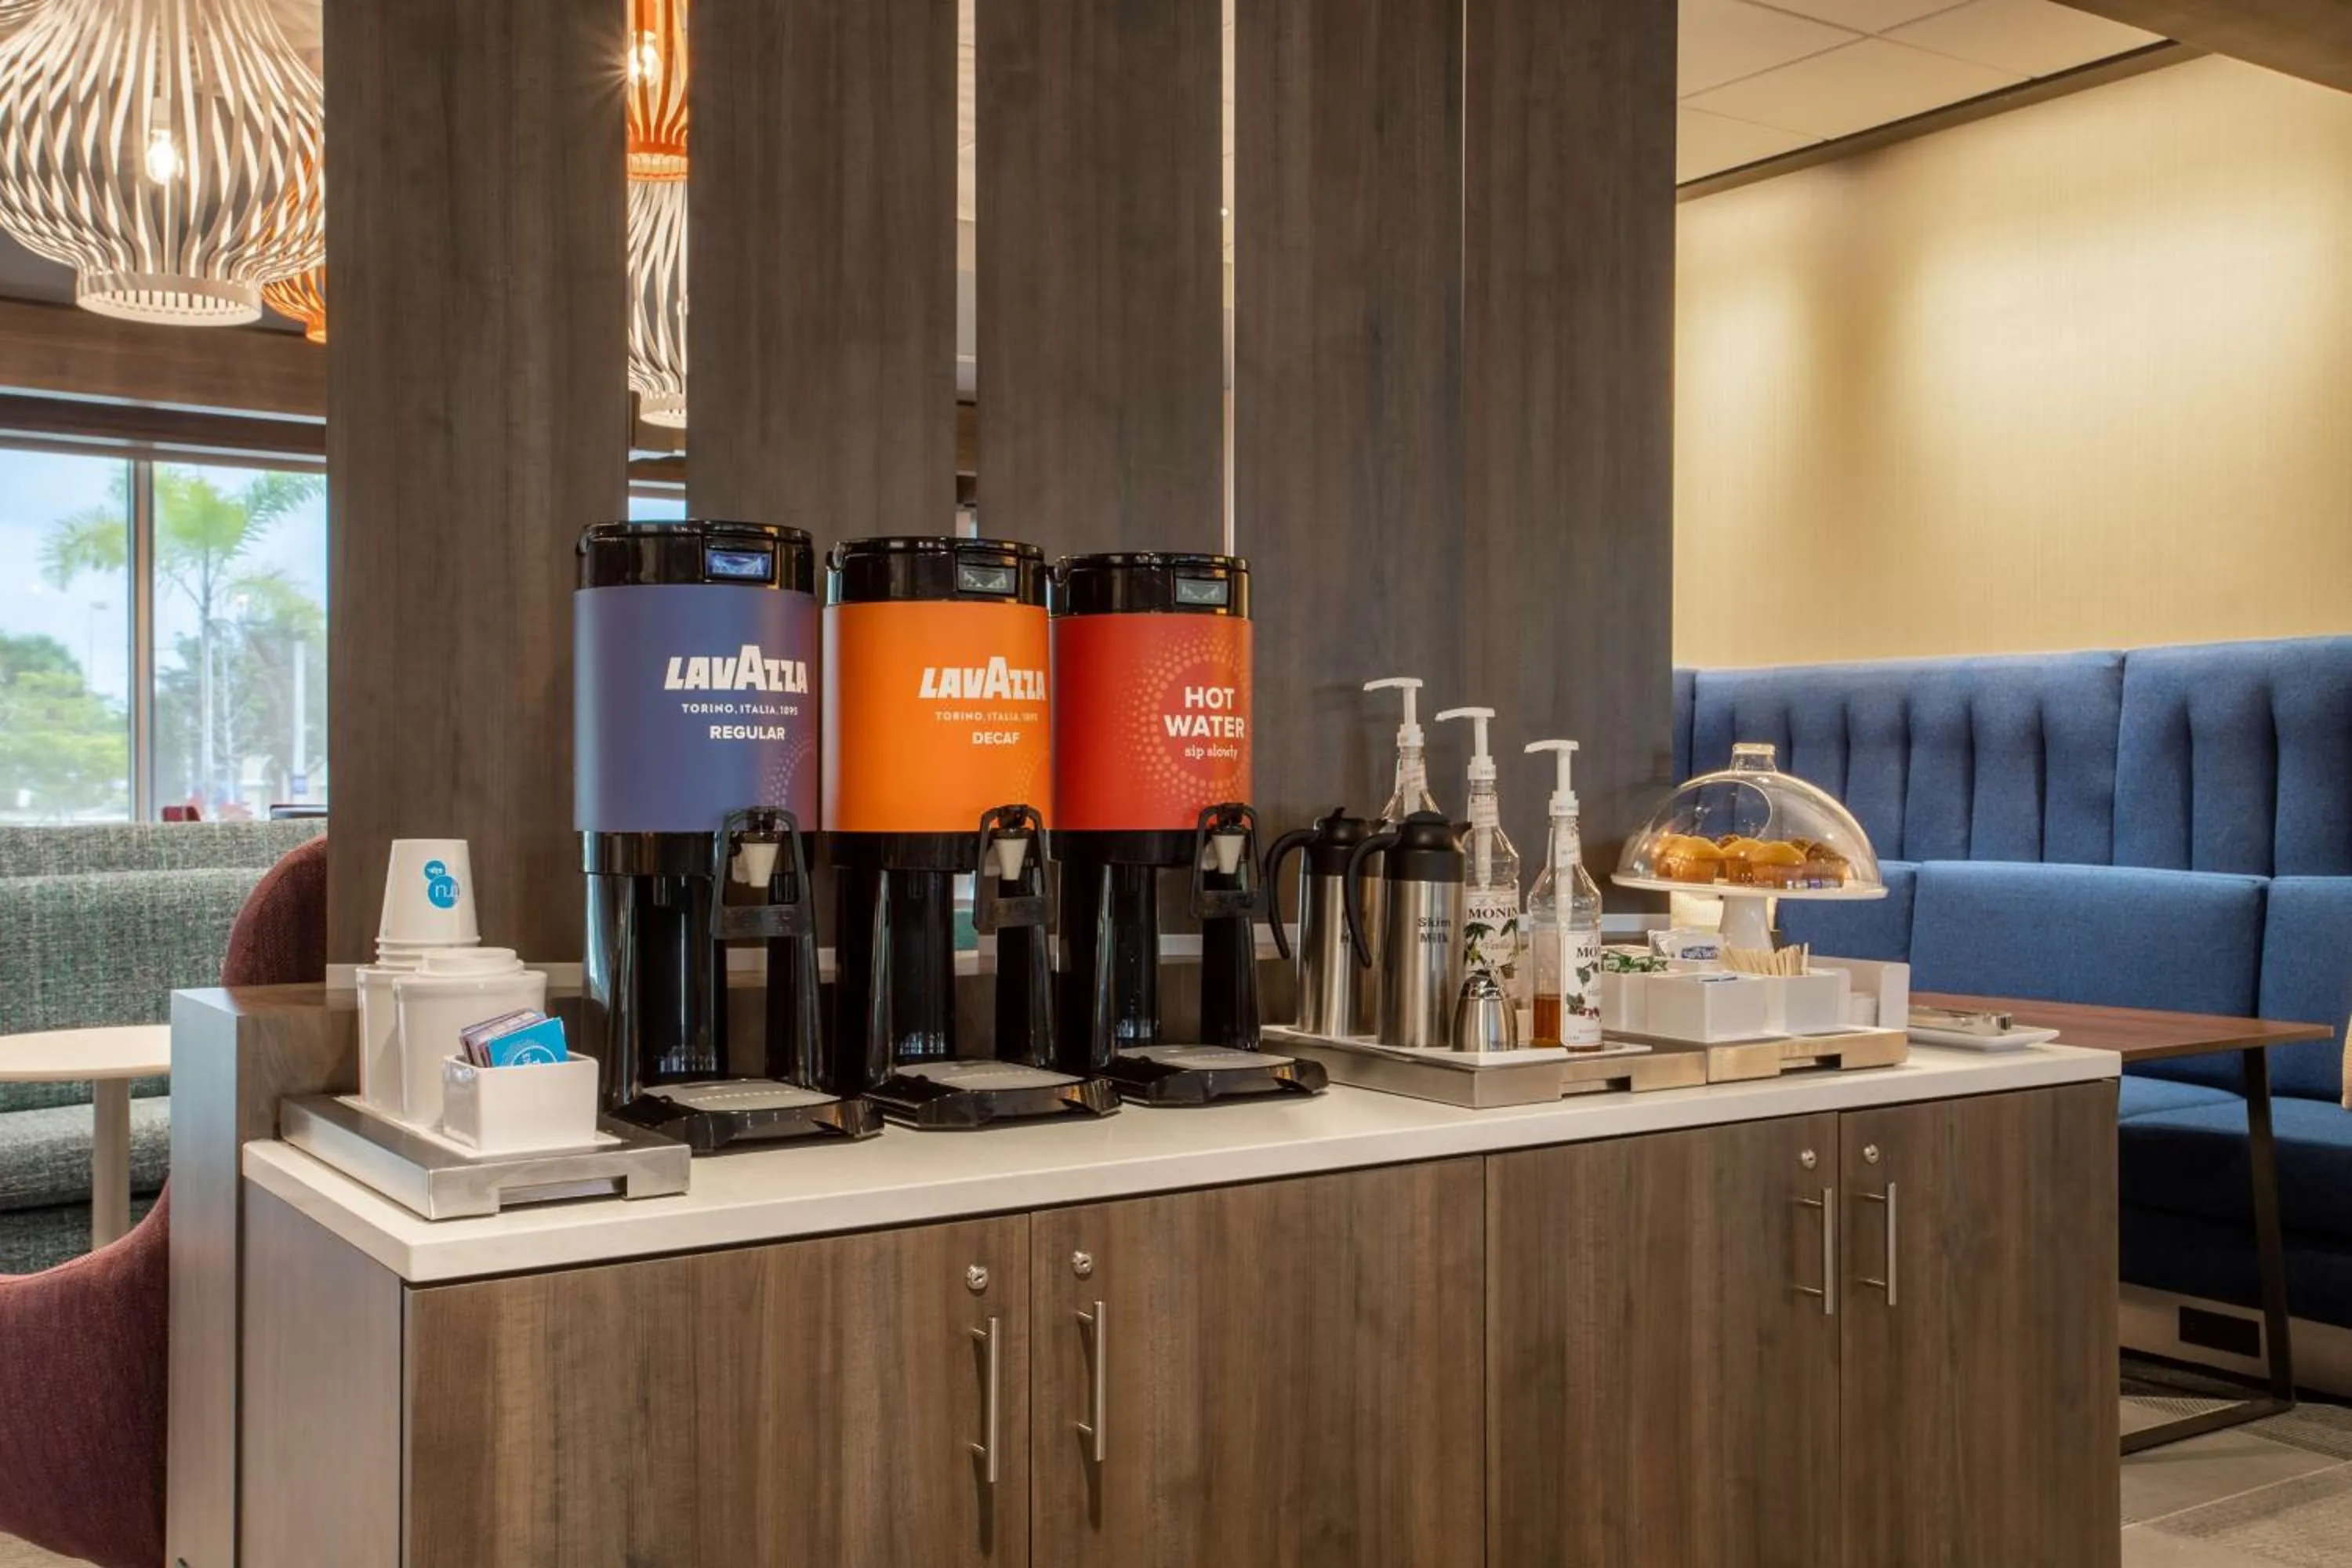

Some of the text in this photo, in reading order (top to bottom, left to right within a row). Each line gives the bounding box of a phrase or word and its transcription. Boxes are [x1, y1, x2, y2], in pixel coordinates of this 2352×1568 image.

[665, 644, 808, 694] LAVAZZA
[918, 656, 1046, 701] LAVAZZA
[1185, 686, 1235, 710] HOT
[710, 725, 785, 740] REGULAR
[972, 731, 1020, 744] DECAF
[1163, 714, 1244, 739] WATER
[1185, 744, 1204, 760] sip
